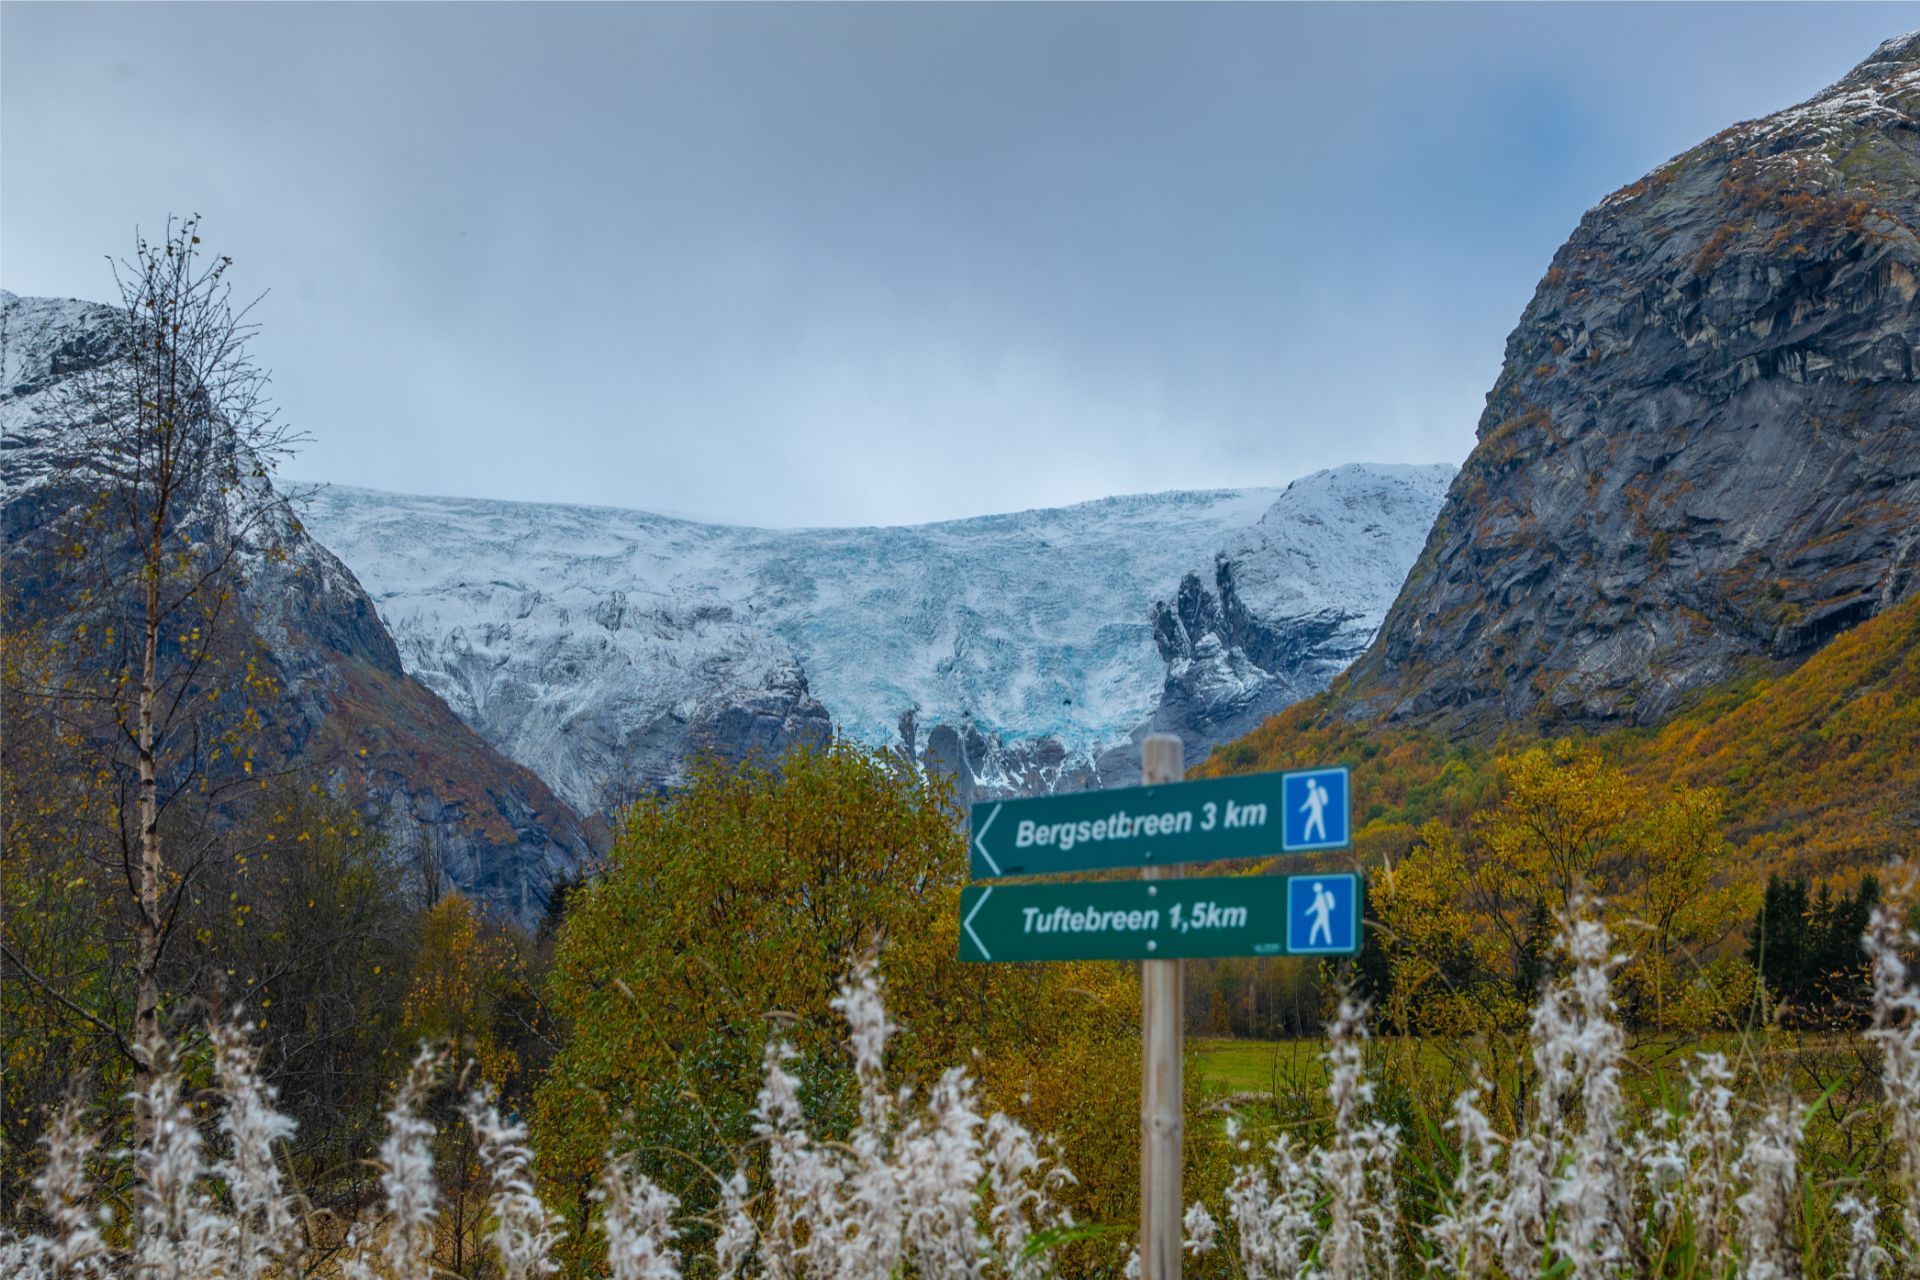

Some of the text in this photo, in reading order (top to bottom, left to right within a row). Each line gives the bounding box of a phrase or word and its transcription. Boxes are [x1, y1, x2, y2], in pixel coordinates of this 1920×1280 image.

[1015, 800, 1267, 850] Bergsetbreen 3 km
[1022, 902, 1247, 933] Tuftebreen 1,5km
